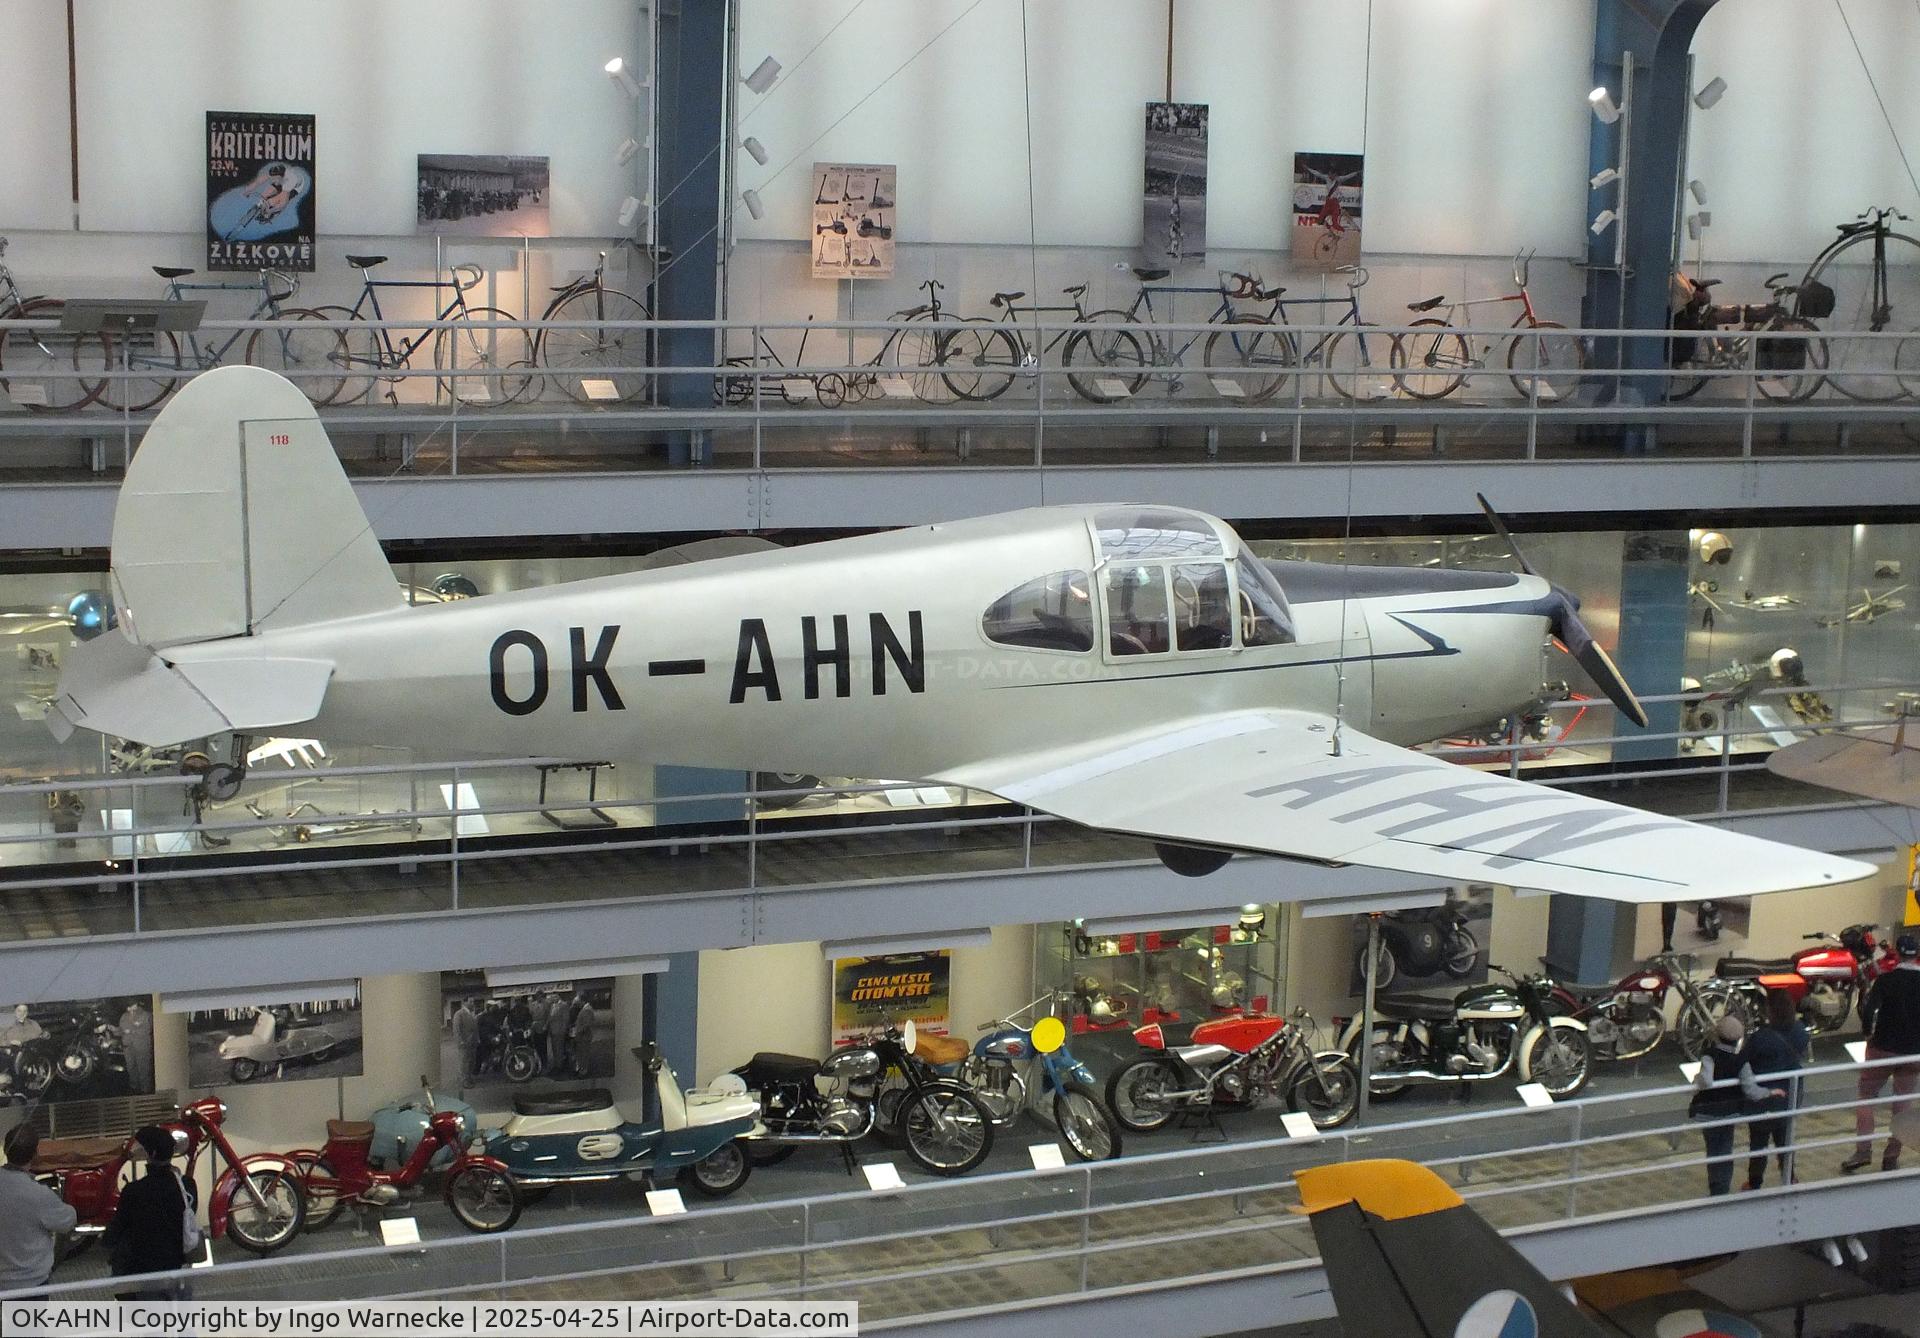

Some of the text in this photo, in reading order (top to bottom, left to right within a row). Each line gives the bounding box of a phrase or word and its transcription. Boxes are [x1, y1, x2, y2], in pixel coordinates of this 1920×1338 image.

[211, 132, 312, 160] KRITERIUM
[299, 235, 311, 244] NA
[211, 241, 310, 259] ŽIŽKOVĚ
[270, 435, 289, 445] 118
[1244, 765, 1696, 870] AHN
[1424, 934, 1433, 948] 9
